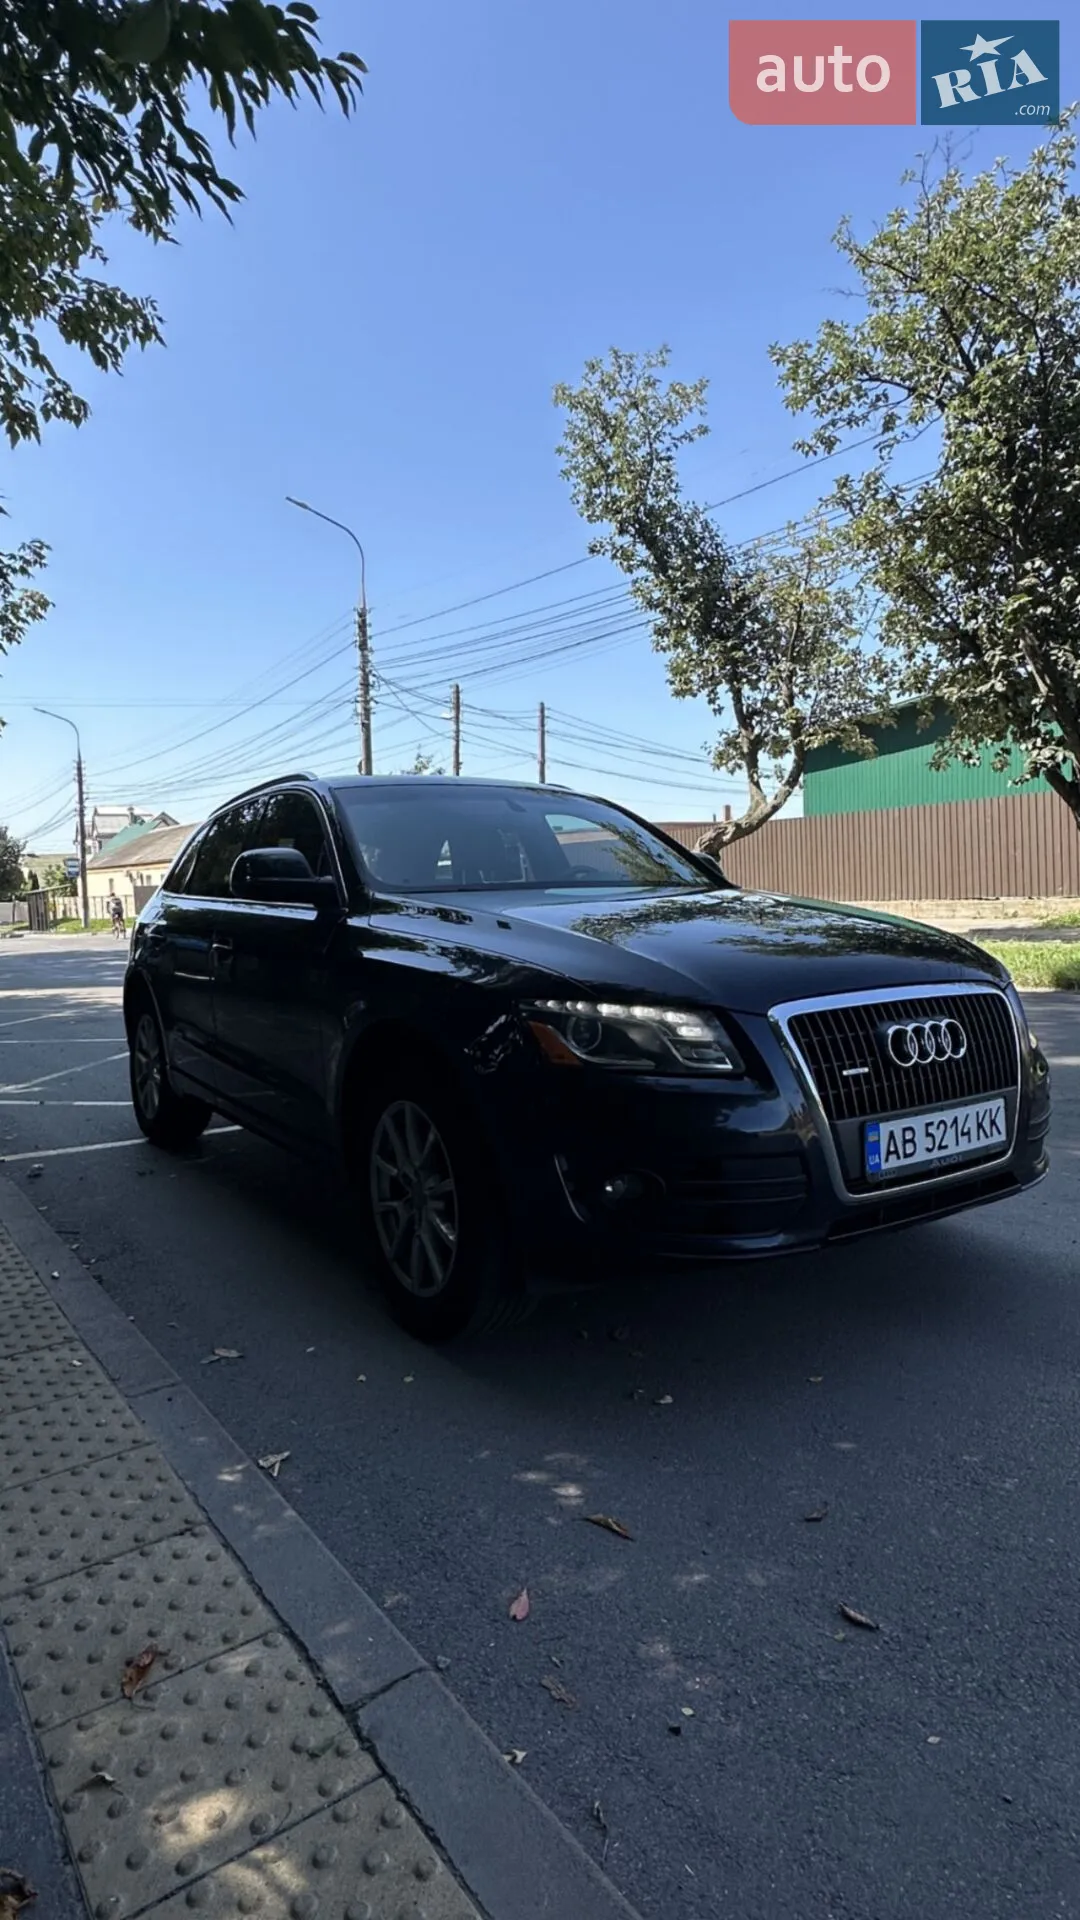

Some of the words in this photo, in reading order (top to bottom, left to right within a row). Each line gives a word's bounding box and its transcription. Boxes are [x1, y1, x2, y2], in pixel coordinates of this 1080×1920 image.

[885, 1126, 917, 1163] AB
[925, 1114, 972, 1153] 5214
[976, 1106, 1002, 1141] KK
[869, 1154, 880, 1165] UA
